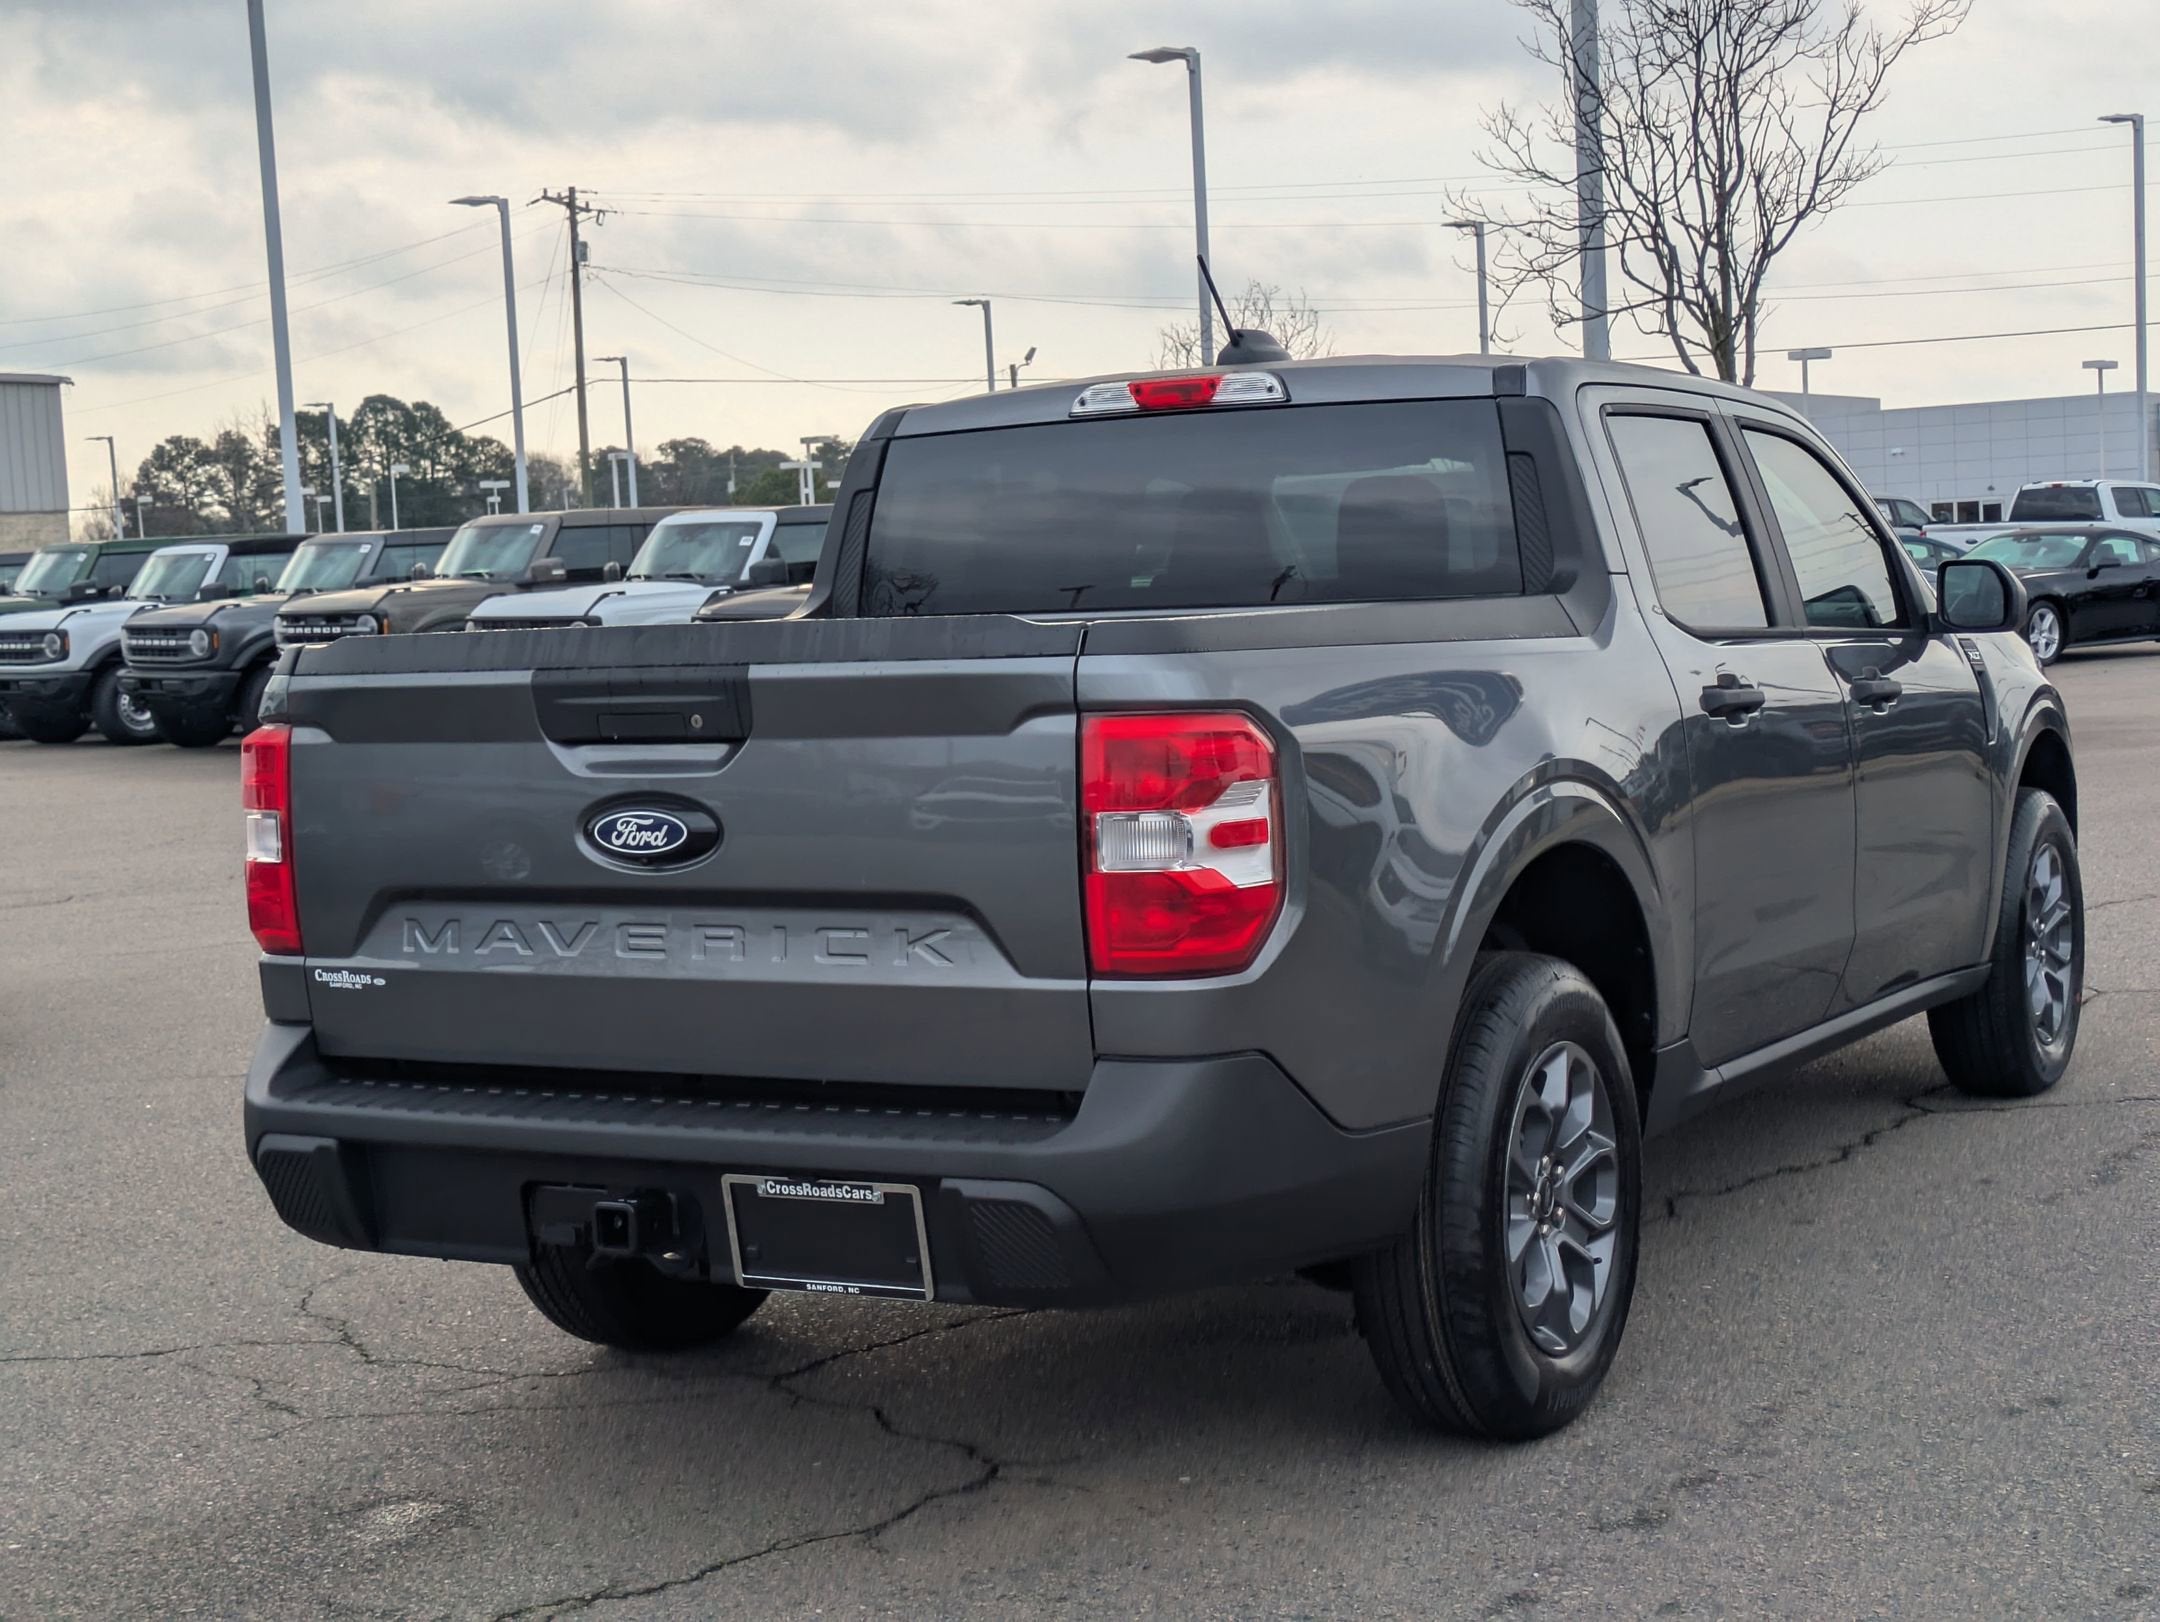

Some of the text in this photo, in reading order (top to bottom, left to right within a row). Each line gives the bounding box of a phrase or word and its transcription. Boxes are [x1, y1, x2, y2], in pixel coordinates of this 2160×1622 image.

[611, 817, 669, 846] Ford
[402, 917, 955, 967] MAVERICK
[766, 1180, 873, 1200] CrossRoadsCars
[806, 1283, 847, 1294] SANFORD,
